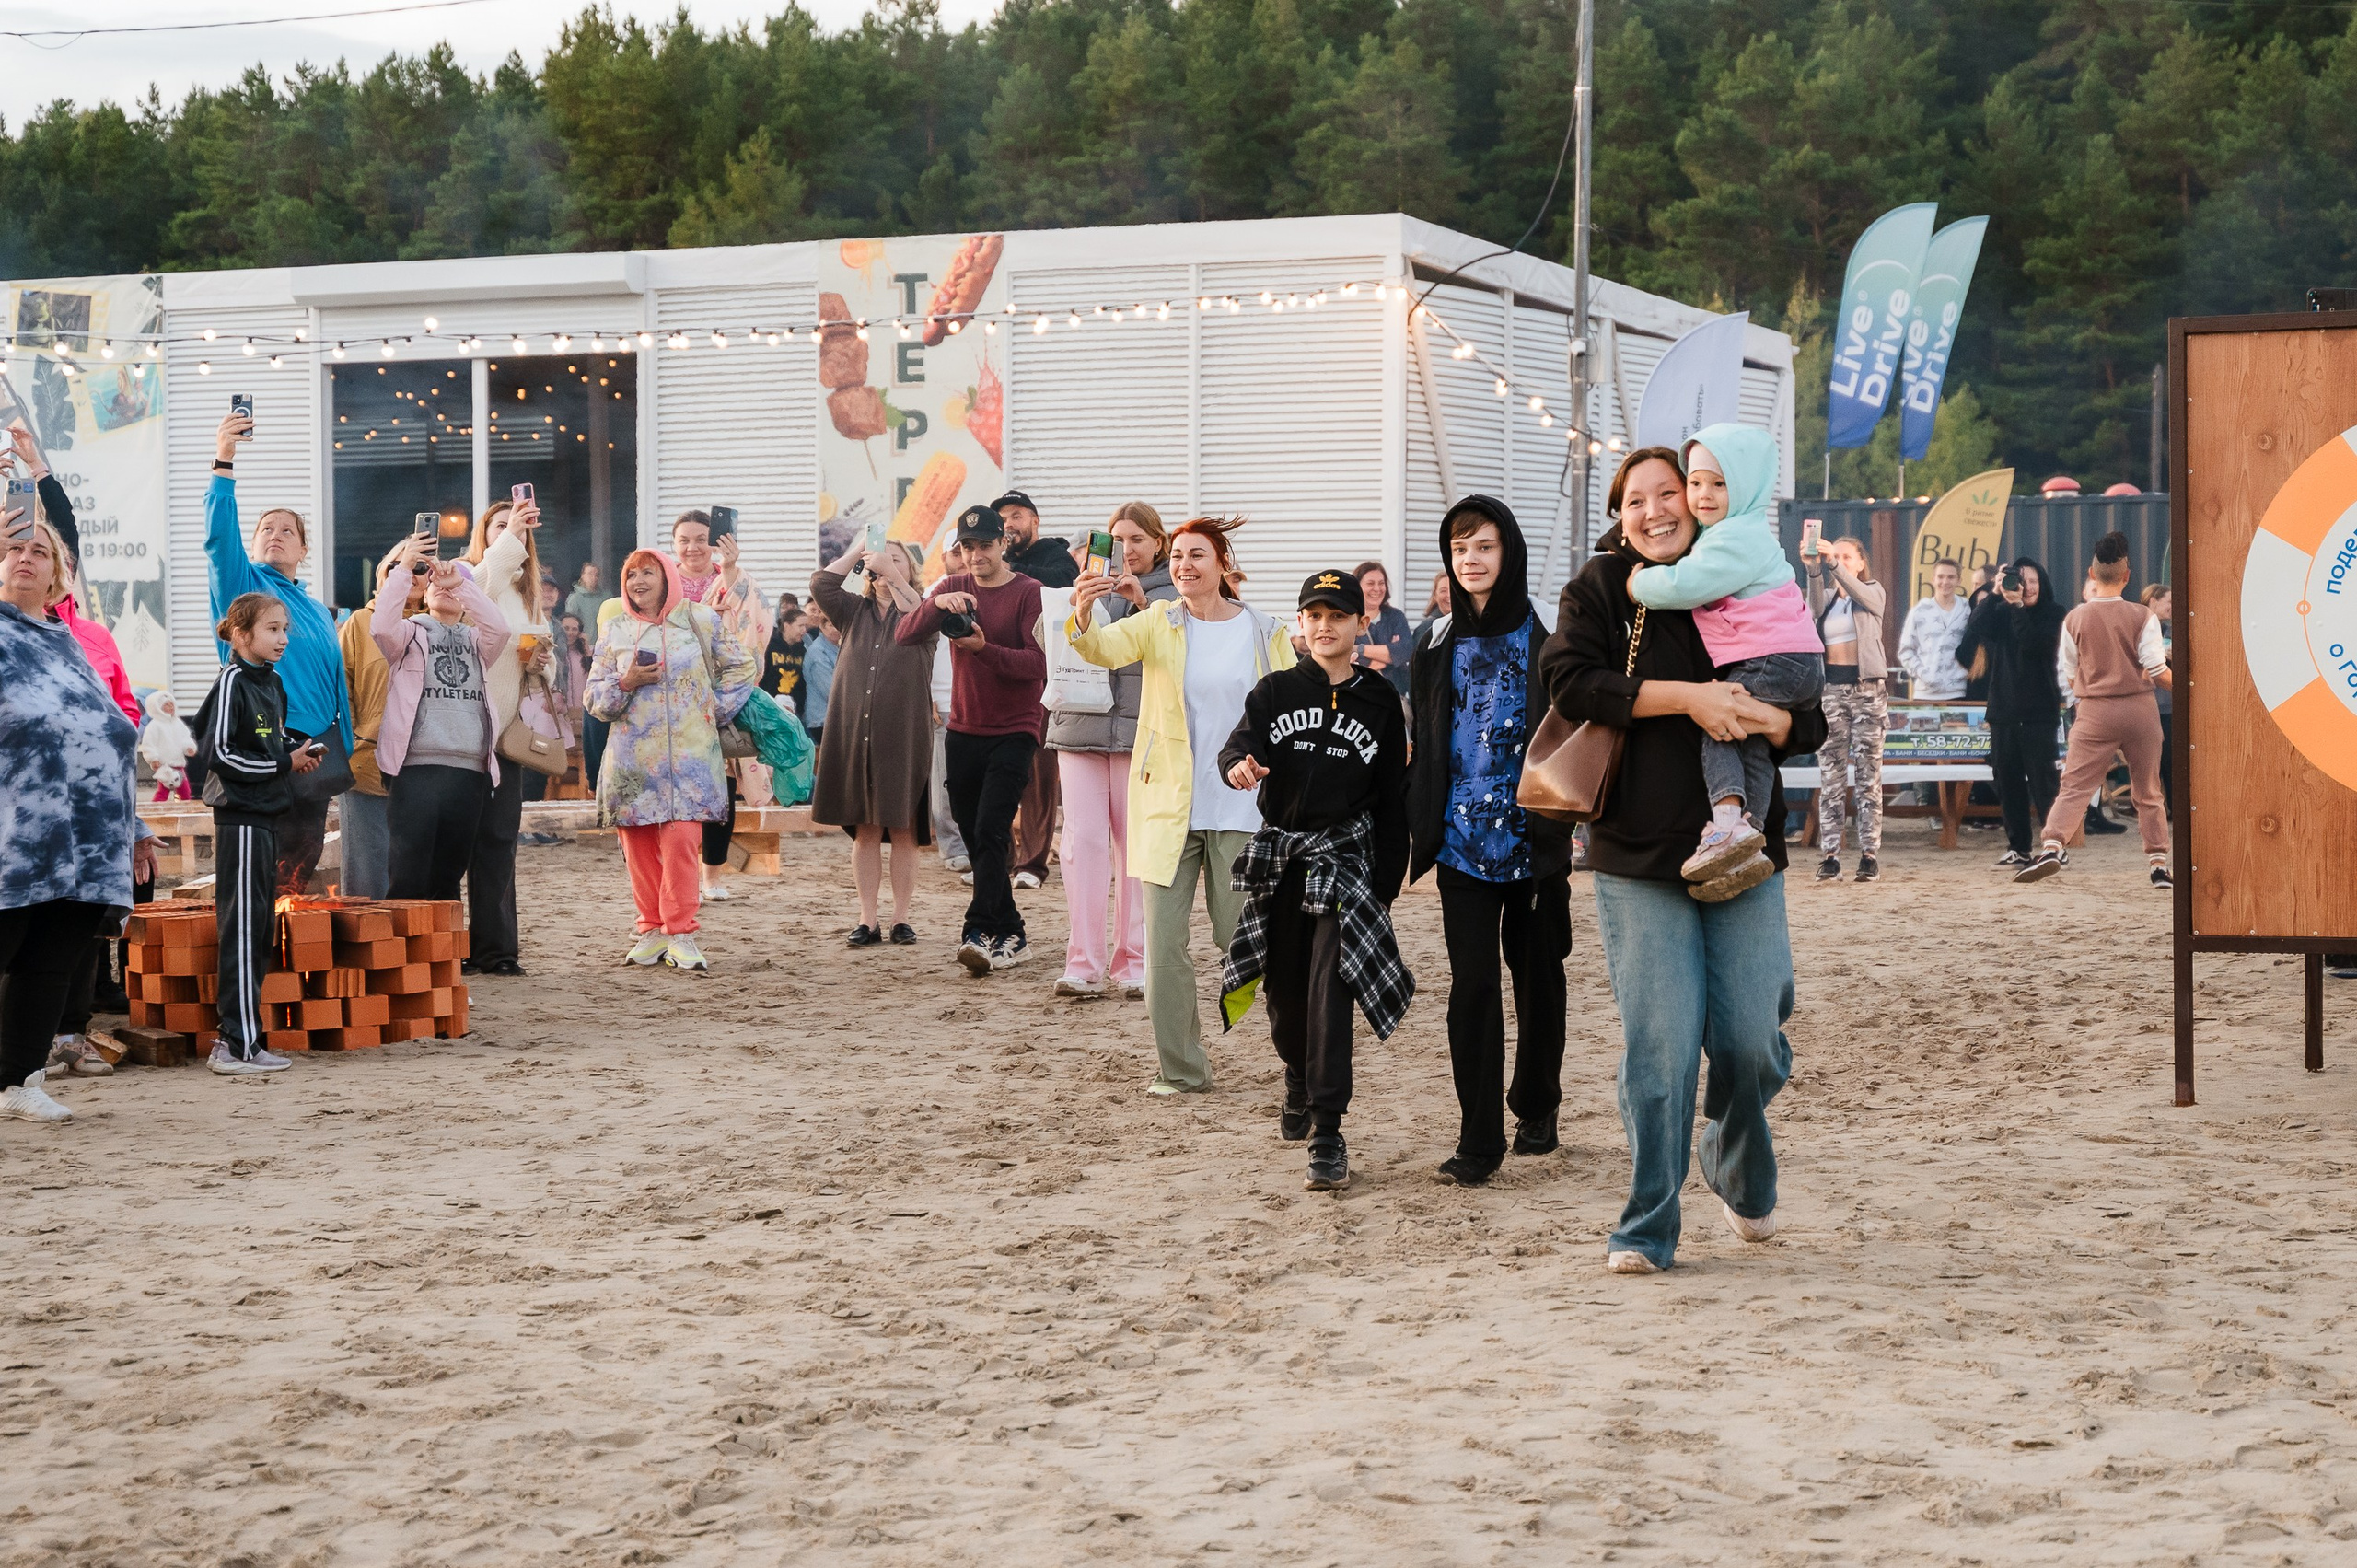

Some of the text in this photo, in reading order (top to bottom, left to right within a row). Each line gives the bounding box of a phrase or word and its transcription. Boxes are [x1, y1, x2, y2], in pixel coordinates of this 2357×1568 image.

[1859, 289, 1910, 408] Drive
[1908, 300, 1958, 413] Drive
[99, 542, 147, 557] 19:00
[2327, 528, 2357, 594] поде
[1313, 581, 1341, 590] adidas
[2339, 659, 2357, 698] Го
[1269, 707, 1323, 744] GOOD
[1331, 712, 1379, 764] LUCK
[1293, 740, 1316, 751] DON'T
[1326, 747, 1349, 758] STOP
